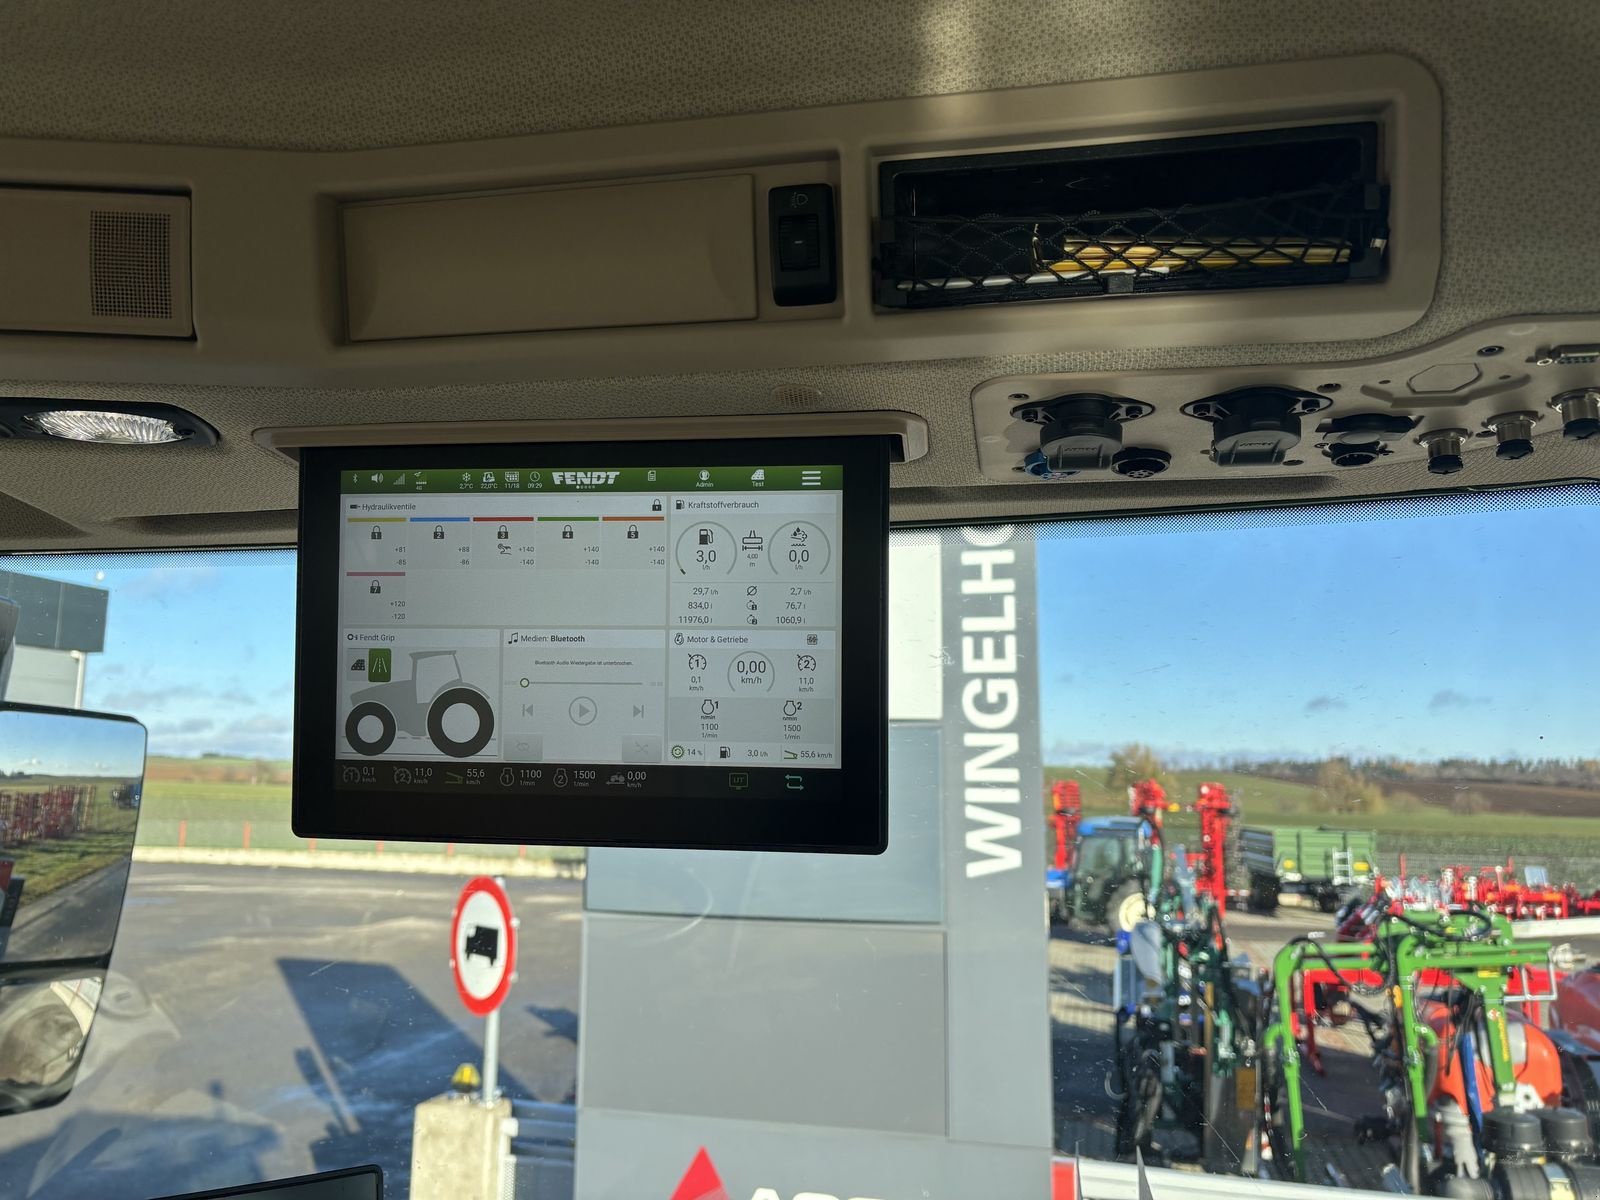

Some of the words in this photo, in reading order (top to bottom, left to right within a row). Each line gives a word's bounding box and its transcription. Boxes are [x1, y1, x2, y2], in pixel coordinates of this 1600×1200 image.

[552, 472, 620, 484] FENDT
[362, 503, 416, 511] Hydraulikventile
[688, 501, 759, 509] Kraftstoffverbrauch
[696, 550, 716, 564] 3,0
[789, 549, 809, 564] 0,0
[693, 587, 709, 596] 29,7
[790, 588, 802, 596] 2,7
[688, 602, 709, 611] 834,0
[785, 602, 802, 611] 76,7
[679, 616, 709, 625] 11976,0
[776, 617, 802, 625] 1060,9
[380, 634, 395, 642] Grip
[717, 636, 748, 644] Getriebe
[737, 660, 766, 675] 0,00
[691, 676, 701, 684] 0,1
[799, 678, 814, 686] 11,0
[747, 750, 758, 758] 3,0
[800, 751, 815, 759] 55,6
[362, 767, 375, 776] 0,1
[415, 768, 433, 777] 11,0
[467, 769, 485, 778] 55,6
[520, 770, 542, 778] 1100
[574, 770, 595, 779] 1500
[627, 771, 646, 781] 0,00
